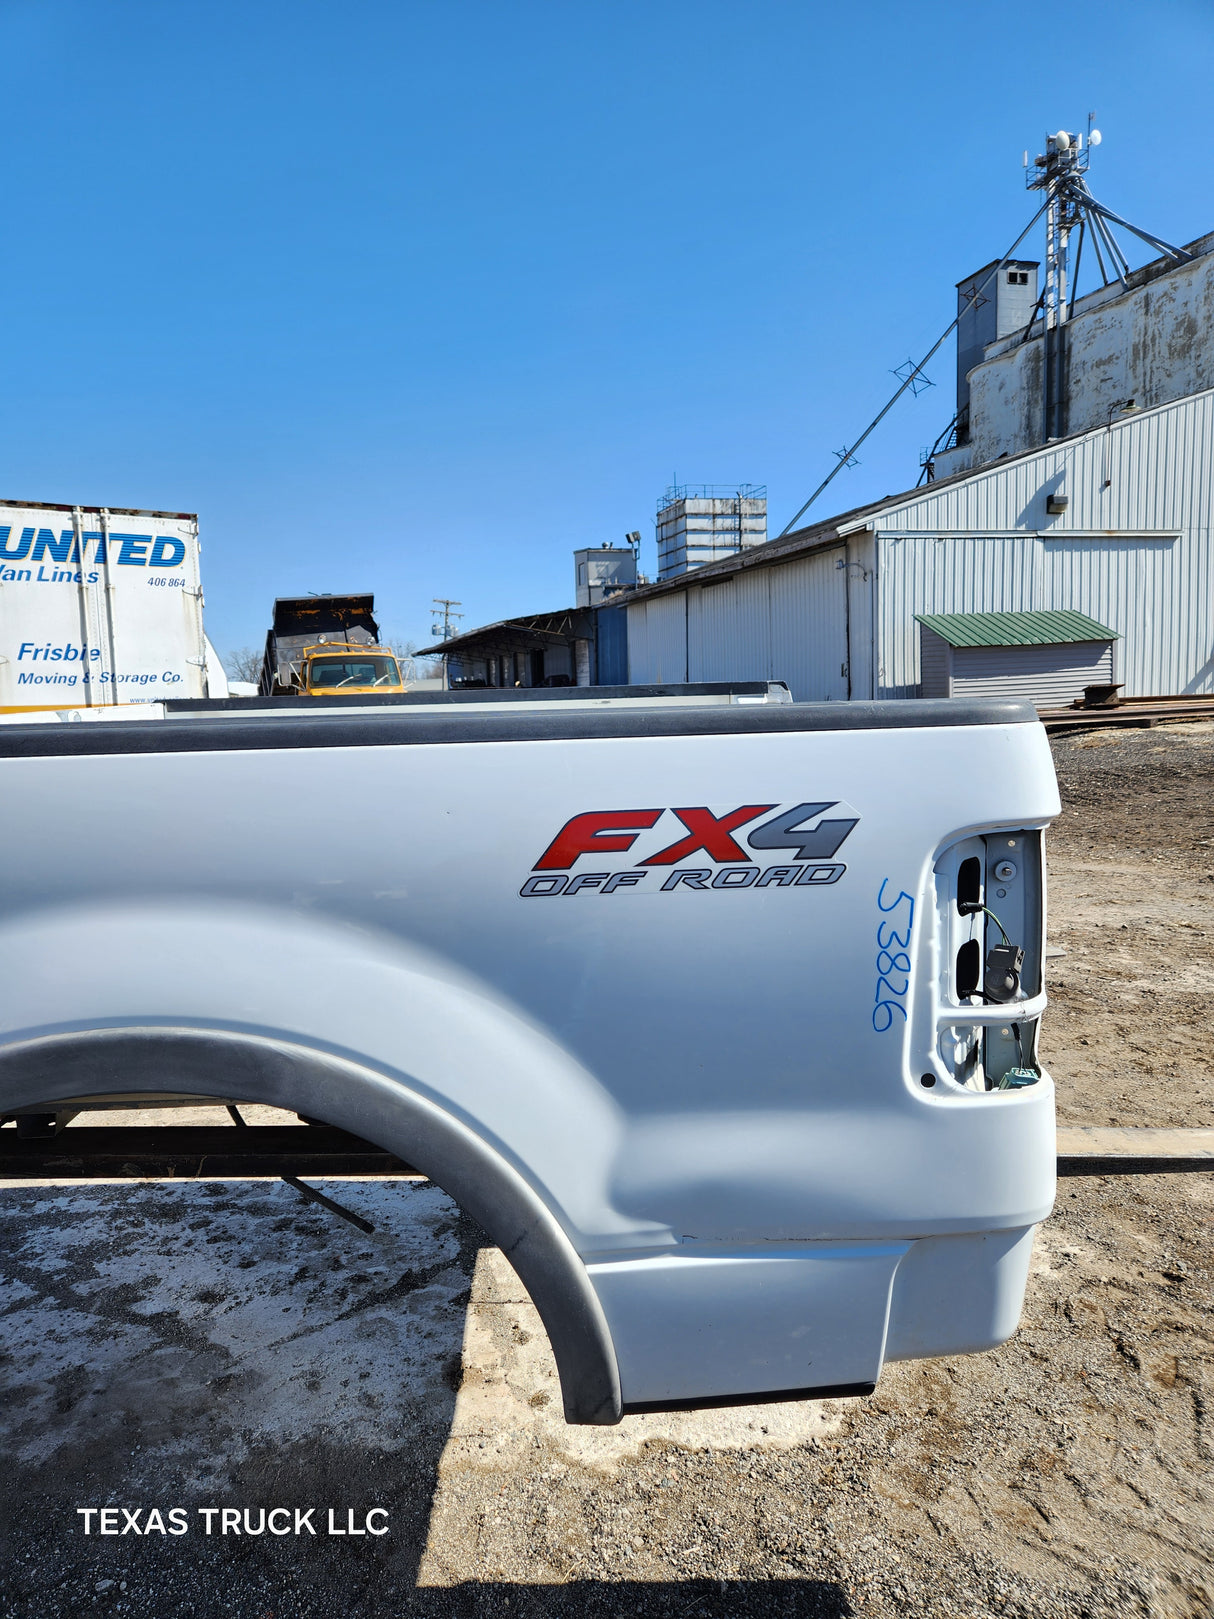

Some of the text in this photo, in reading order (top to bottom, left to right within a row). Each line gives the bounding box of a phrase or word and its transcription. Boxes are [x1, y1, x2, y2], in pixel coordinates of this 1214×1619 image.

[0, 525, 186, 568] UNITED
[37, 565, 99, 584] Lines
[147, 577, 186, 588] 406 864
[17, 642, 101, 662] Frisbie
[17, 672, 78, 687] Moving
[99, 671, 158, 686] Storage
[161, 670, 184, 684] Co.
[531, 801, 861, 872] FX4
[519, 863, 847, 898] OFF ROAD
[872, 877, 915, 1034] 53826
